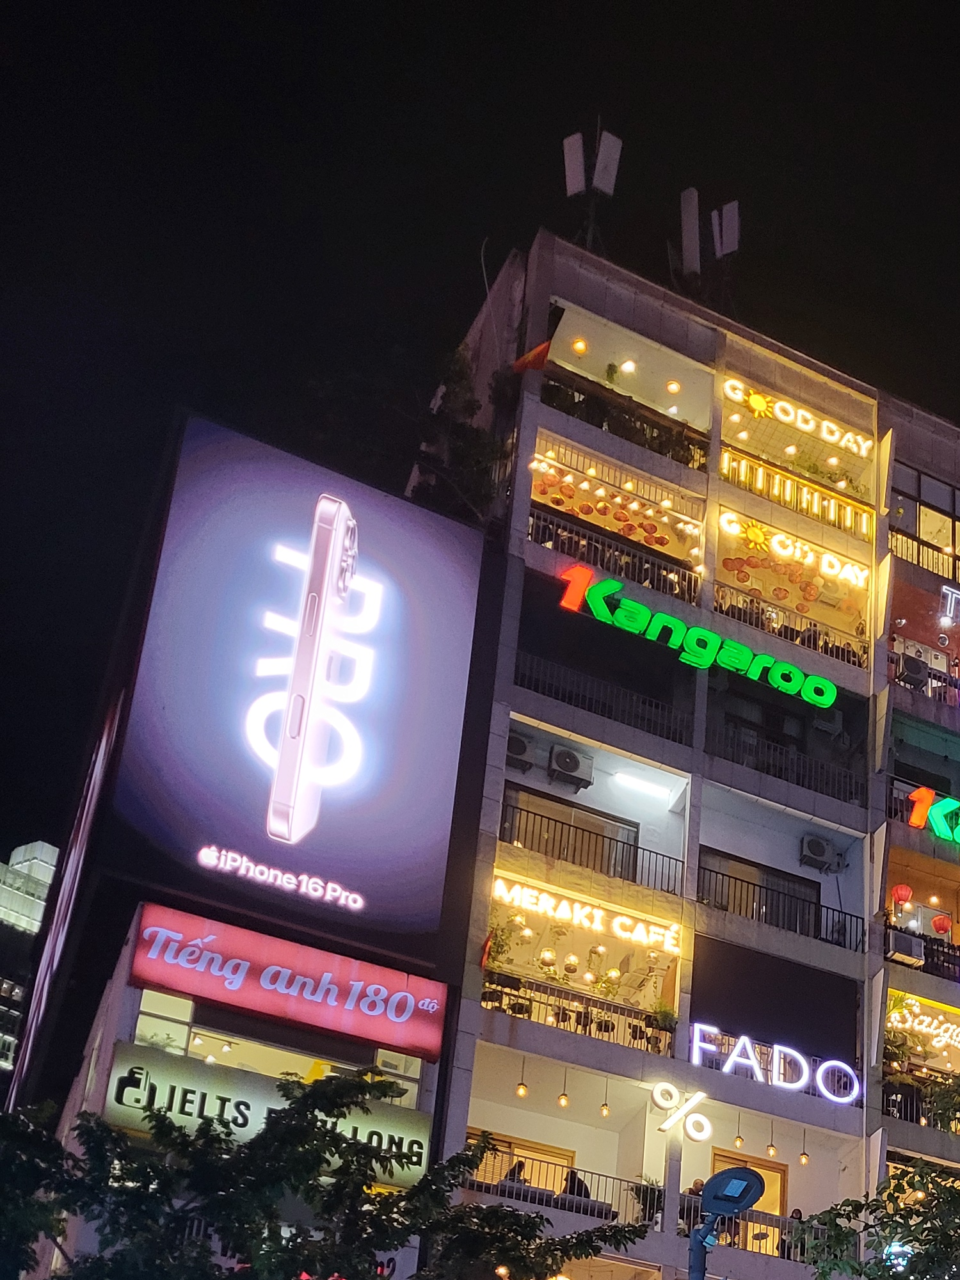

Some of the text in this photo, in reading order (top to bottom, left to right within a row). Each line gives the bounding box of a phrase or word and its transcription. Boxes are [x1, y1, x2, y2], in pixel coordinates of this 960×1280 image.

[820, 420, 873, 458] DAY
[821, 554, 870, 587] DAY
[218, 849, 364, 911] iPhone 16 Pro
[494, 878, 681, 954] MERAKI CAFÉ
[142, 926, 251, 991] Tiếng
[259, 964, 338, 1007] anh
[344, 980, 415, 1023] 180
[692, 1022, 860, 1103] FADO
[166, 1084, 251, 1129] IELTS
